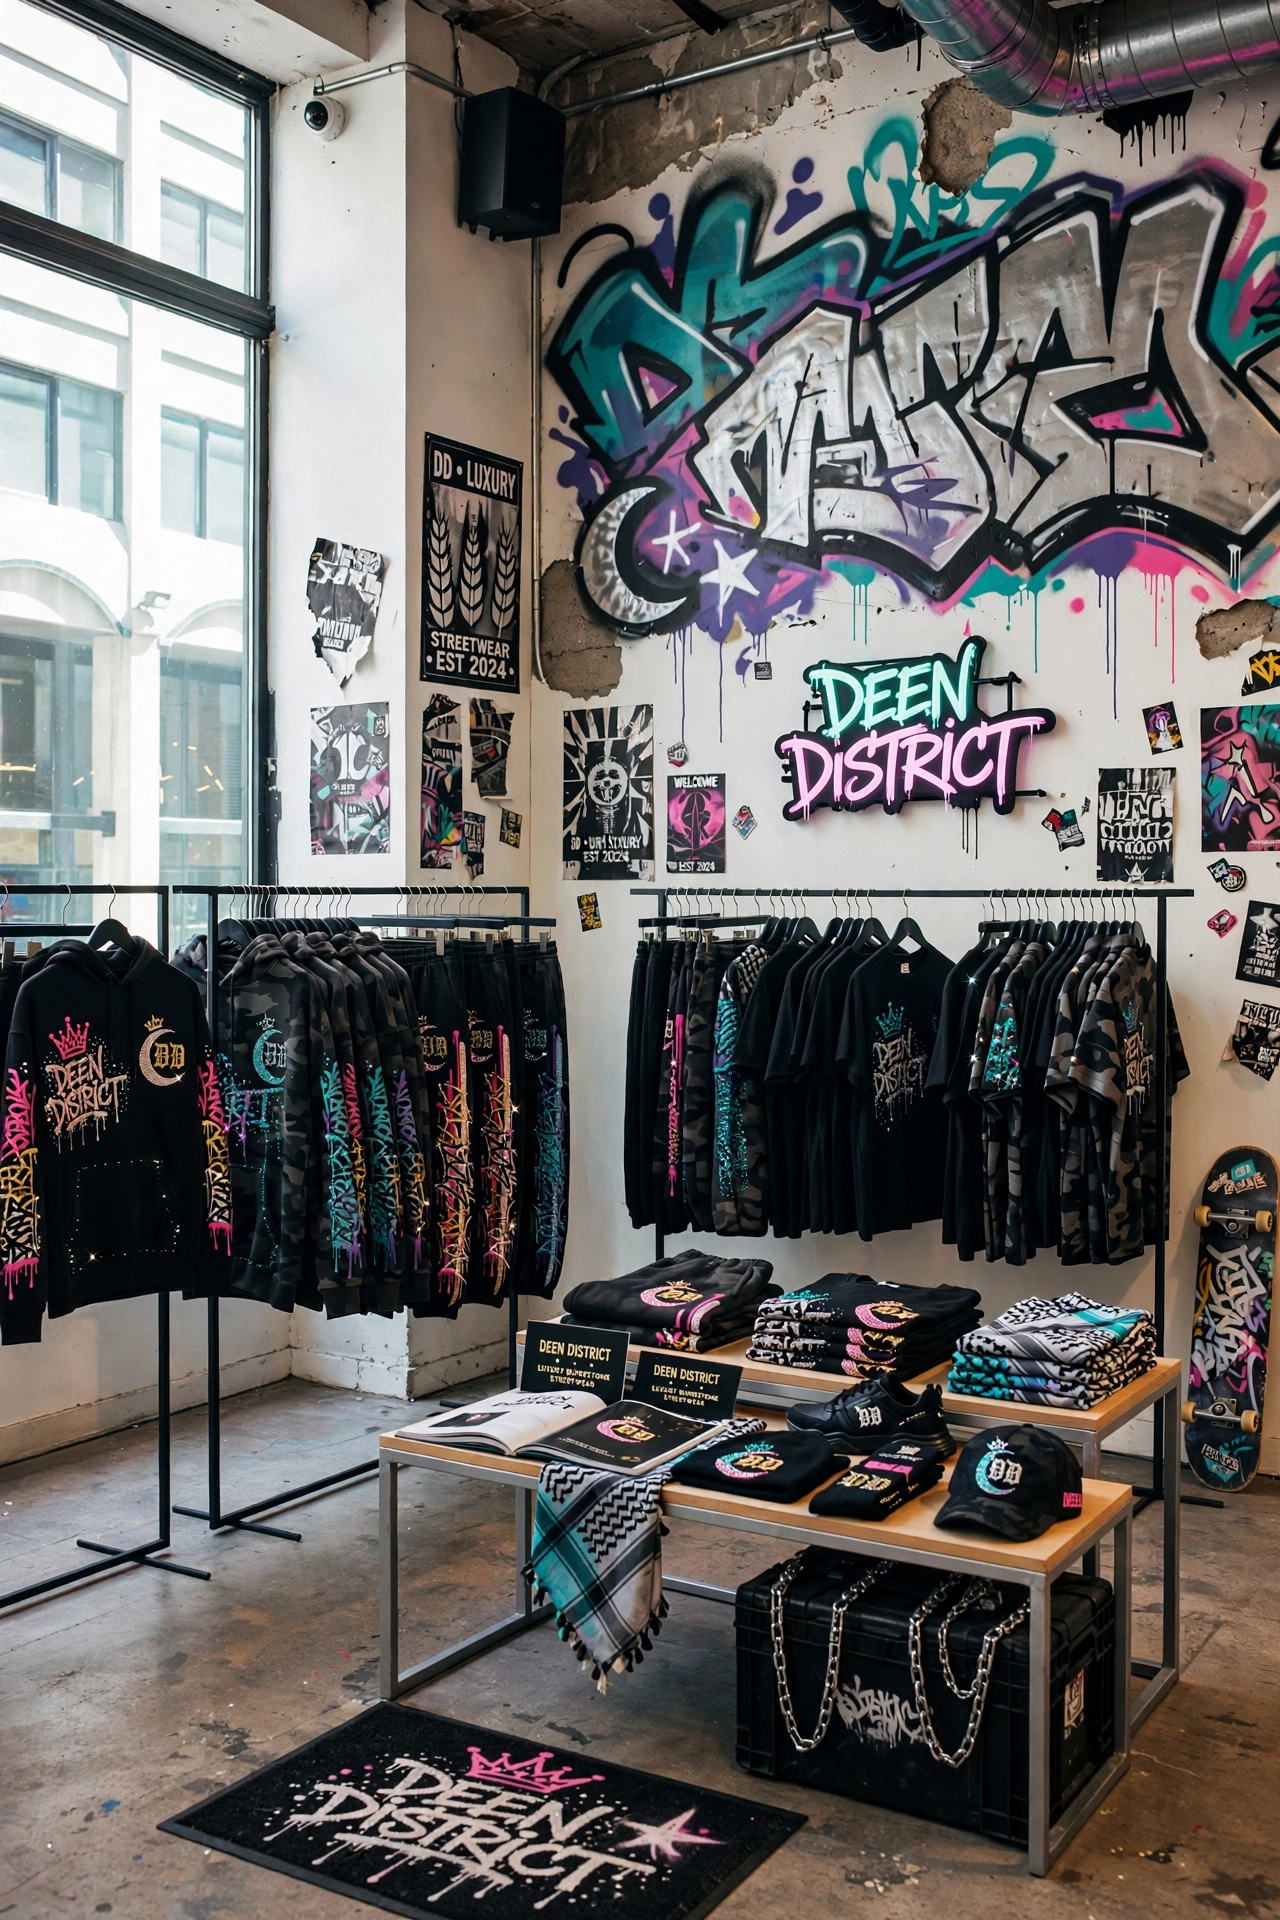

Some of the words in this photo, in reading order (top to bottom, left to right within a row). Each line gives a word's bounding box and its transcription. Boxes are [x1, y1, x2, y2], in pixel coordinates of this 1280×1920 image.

[433, 449, 453, 480] DD
[466, 460, 516, 499] LUXURY
[430, 630, 510, 659] STREETWEAR
[436, 650, 465, 673] EST
[469, 655, 507, 679] 2024
[809, 642, 977, 738] DEEN
[673, 775, 719, 789] WELCOME
[154, 1042, 185, 1069] DD
[45, 1044, 104, 1098] DEEN
[44, 1074, 128, 1136] DISTRICT
[539, 1339, 565, 1355] DEEN
[567, 1343, 612, 1361] DISTRICT
[653, 1364, 678, 1379] DEEN
[679, 1368, 720, 1385] DISTRICT
[377, 1757, 615, 1843] DEEN
